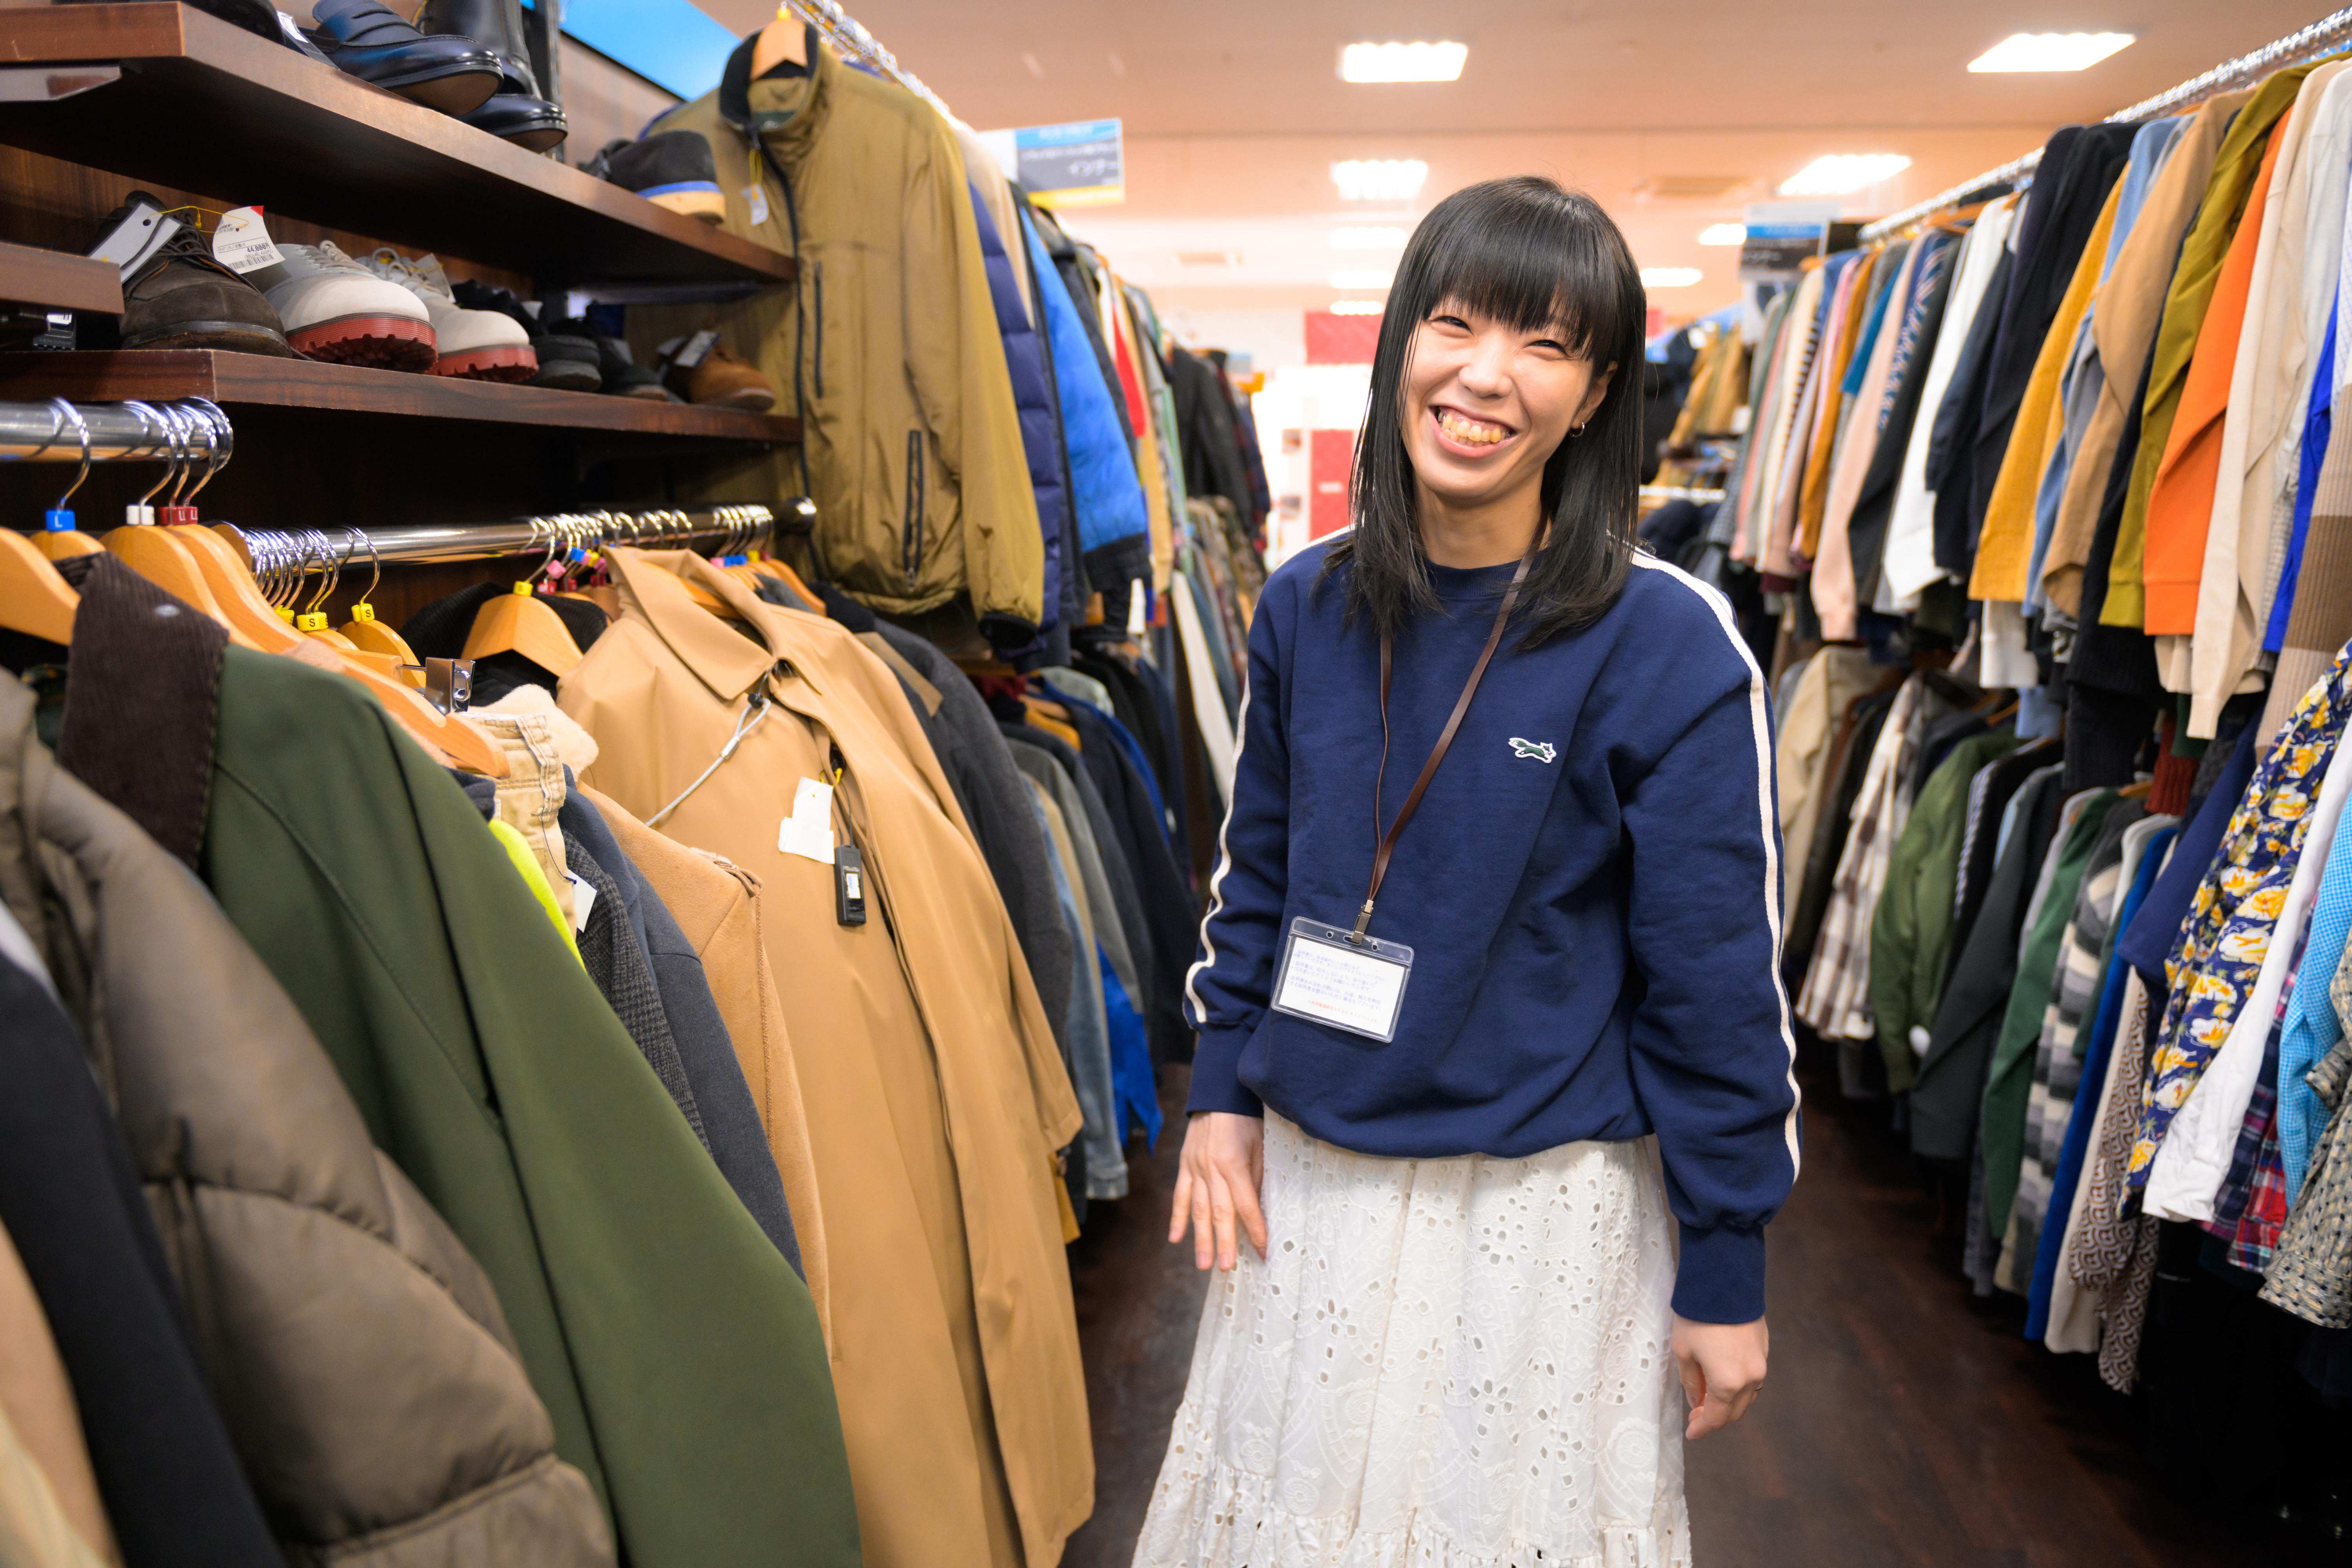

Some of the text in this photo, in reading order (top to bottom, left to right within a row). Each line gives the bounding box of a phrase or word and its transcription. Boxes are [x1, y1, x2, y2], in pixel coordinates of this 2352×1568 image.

[247, 243, 270, 253] 44,000円
[54, 515, 62, 528] L
[309, 618, 316, 627] S
